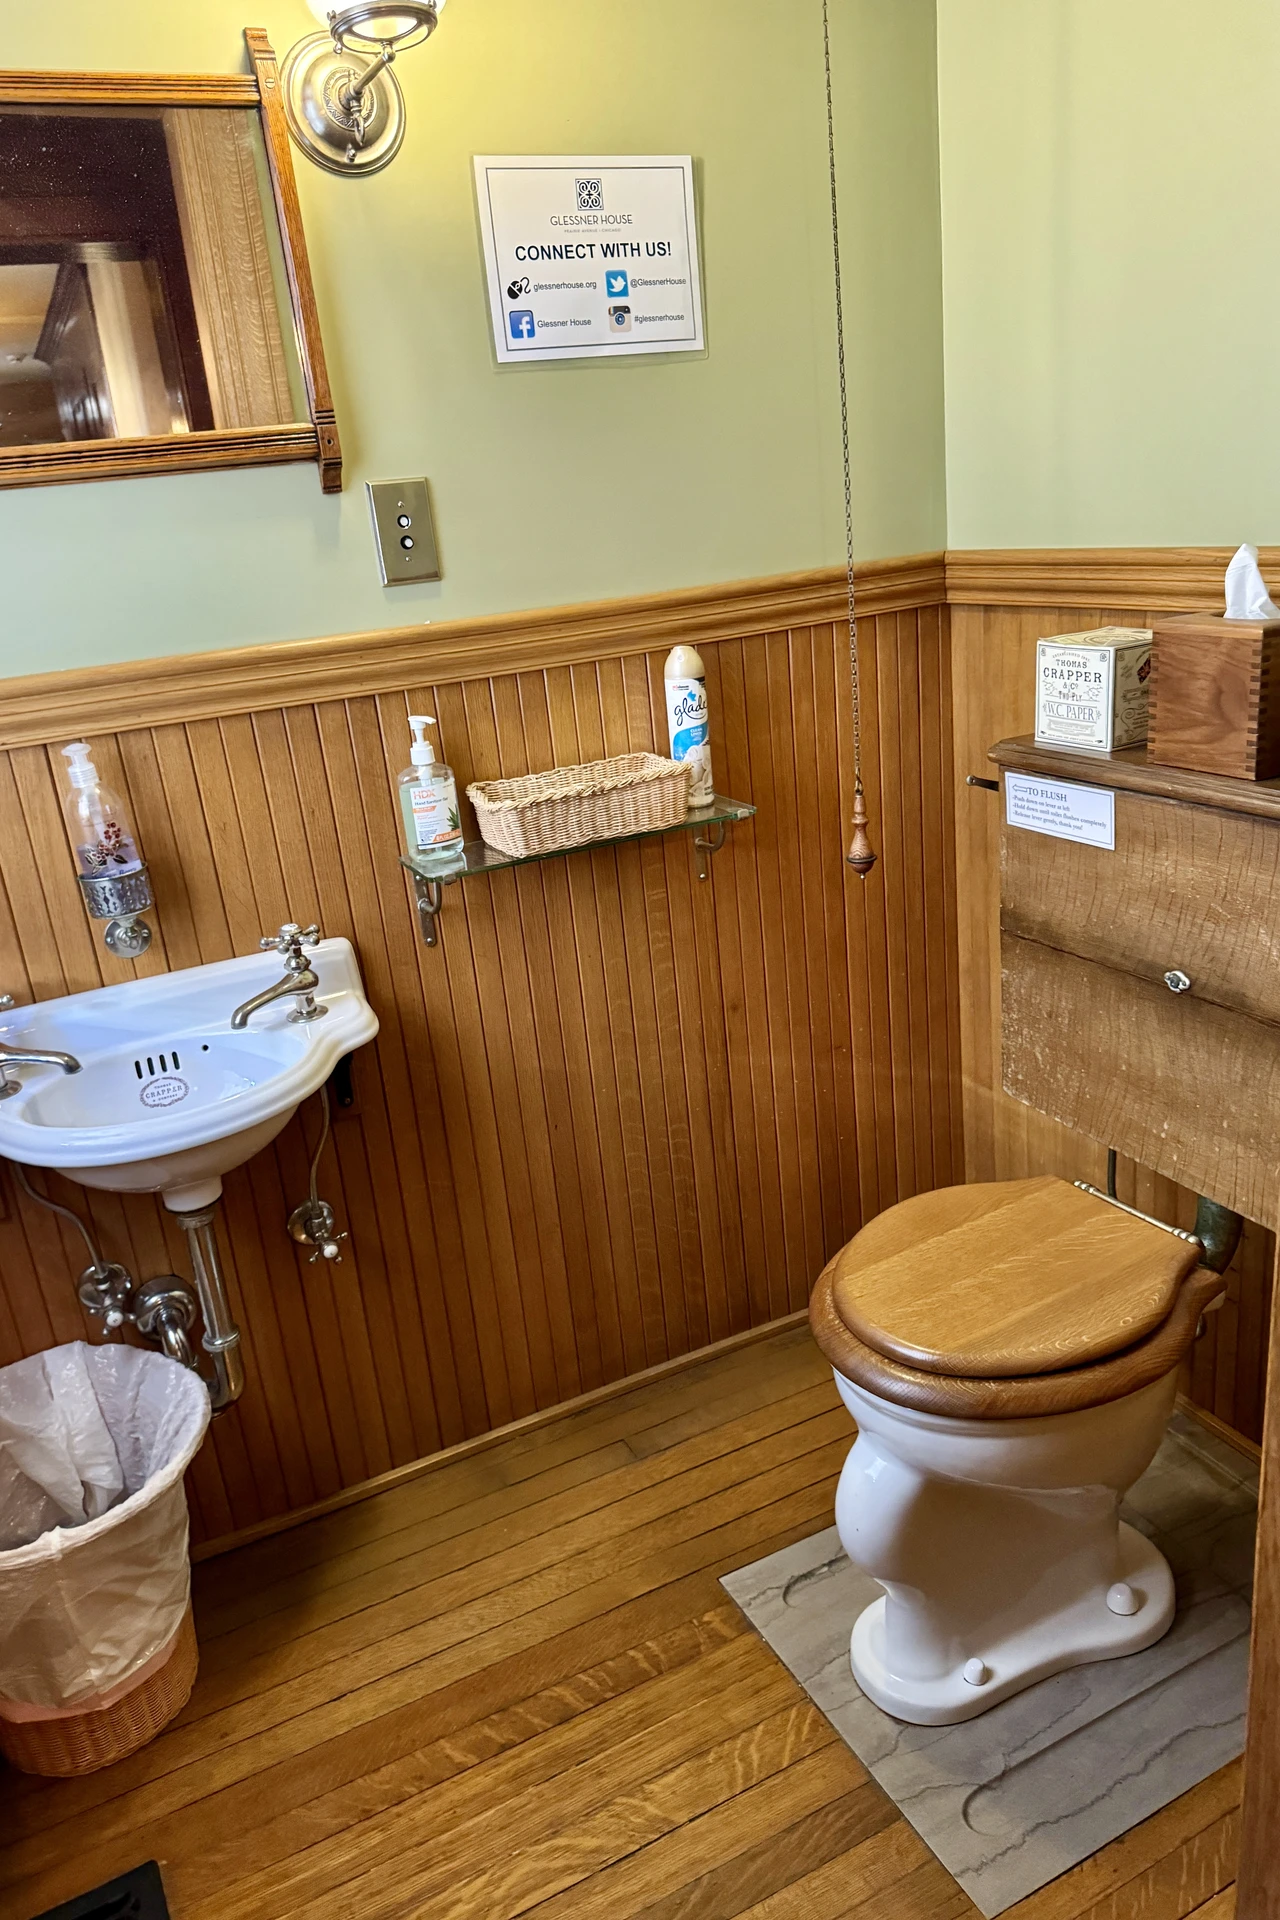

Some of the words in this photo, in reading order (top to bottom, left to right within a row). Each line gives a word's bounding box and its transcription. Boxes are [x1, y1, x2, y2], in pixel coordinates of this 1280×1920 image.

[550, 215, 598, 225] GLESSNER
[601, 214, 633, 224] HOUSE
[515, 244, 596, 261] CONNECT
[601, 242, 640, 258] WITH
[646, 241, 672, 257] US!
[533, 281, 597, 293] glessnerhouse.org
[630, 277, 687, 288] @GlessnerHouse
[537, 319, 568, 328] Glessner
[570, 318, 592, 326] House
[634, 313, 685, 324] #glessnerhouse
[1056, 658, 1087, 669] THOMAS
[1043, 667, 1102, 683] CRAPPER
[1066, 705, 1094, 721] PAPER
[413, 789, 436, 800] HDX
[1027, 787, 1039, 796] TO
[1040, 790, 1067, 802] FLUSH
[1063, 813, 1080, 822] flushes
[1081, 818, 1107, 829] completely
[145, 1085, 183, 1099] CRAPPER
